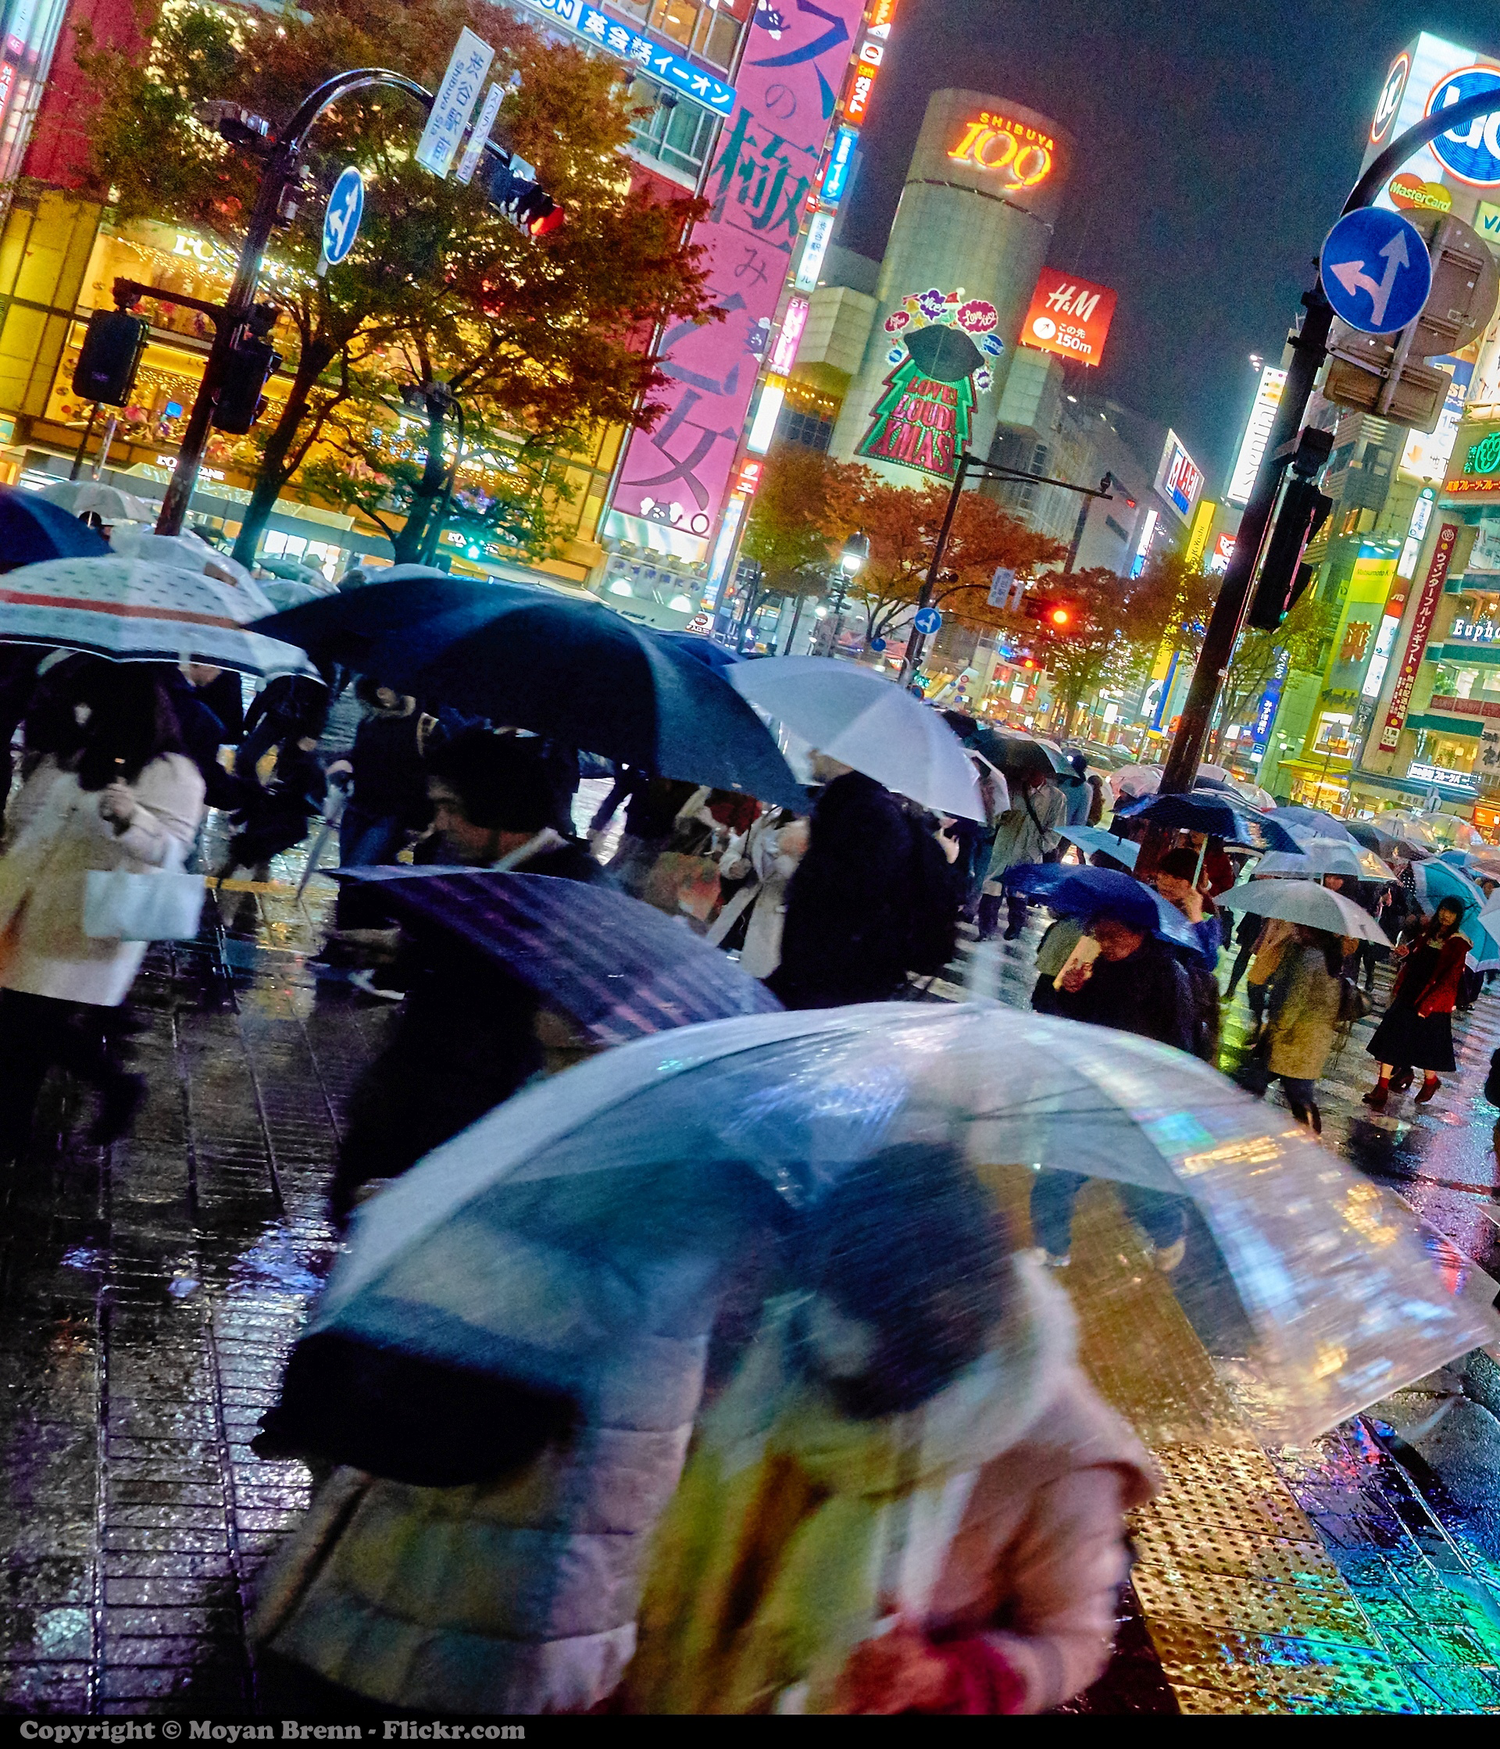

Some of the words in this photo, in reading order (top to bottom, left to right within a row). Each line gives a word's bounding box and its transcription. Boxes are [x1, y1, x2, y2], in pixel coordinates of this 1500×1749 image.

[583, 10, 730, 104] 英会話イーオン
[979, 111, 1054, 150] SHIBUYA
[948, 121, 1052, 190] 109
[1389, 181, 1452, 213] MasterCard
[1045, 282, 1100, 324] H&M
[1055, 332, 1093, 355] 150m
[1058, 321, 1087, 339] この先
